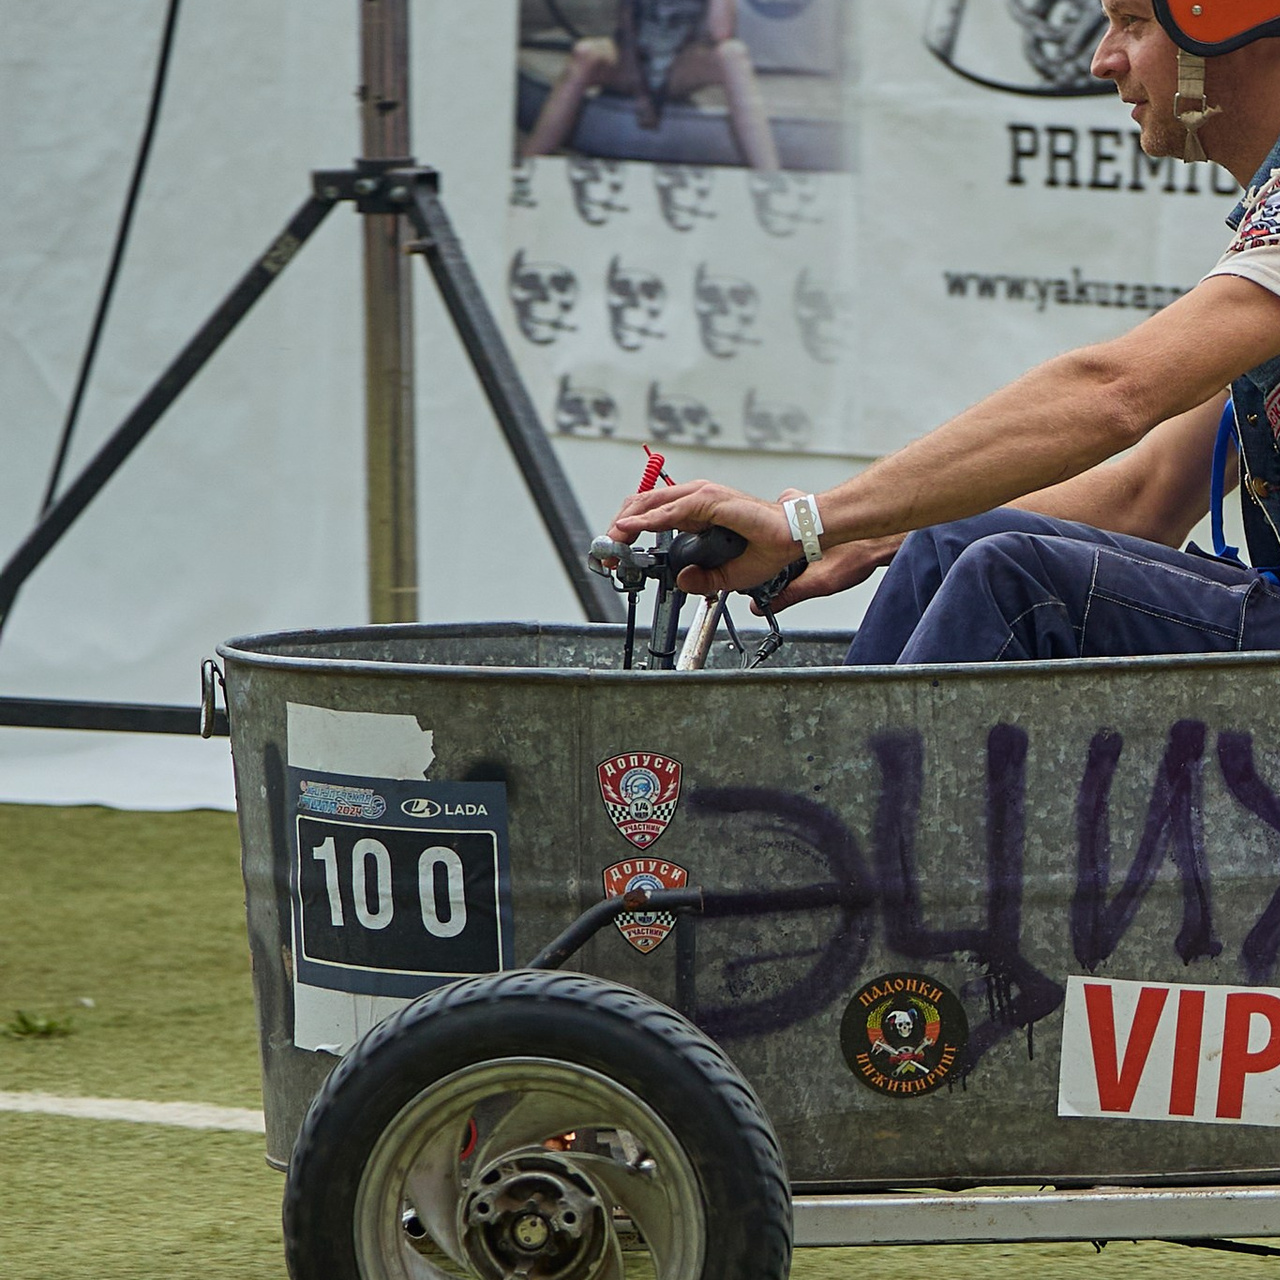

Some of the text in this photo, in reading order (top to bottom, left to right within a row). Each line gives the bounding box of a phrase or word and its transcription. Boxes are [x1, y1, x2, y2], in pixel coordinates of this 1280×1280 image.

[603, 754, 677, 778] ДОПУСК
[444, 803, 488, 816] LADA
[610, 860, 683, 882] ДОПУСК
[858, 978, 944, 1008] ПАДОНКИ
